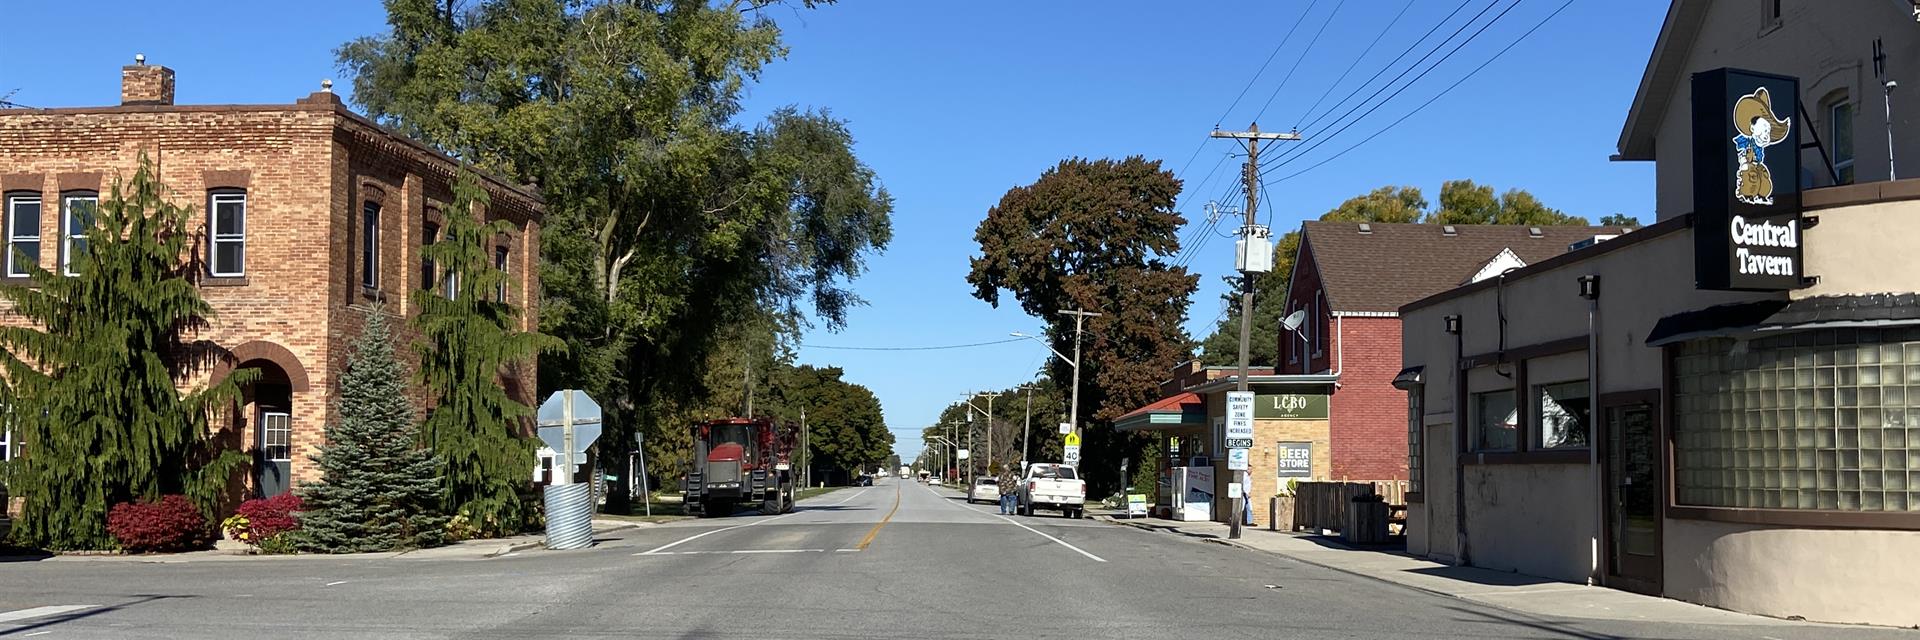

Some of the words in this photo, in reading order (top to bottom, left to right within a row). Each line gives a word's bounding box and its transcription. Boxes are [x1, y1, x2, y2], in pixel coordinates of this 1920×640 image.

[1731, 215, 1797, 248] Central
[1736, 247, 1793, 276] Tavern
[1273, 396, 1307, 409] LCBO
[1228, 439, 1251, 447] BEGINS
[1066, 452, 1077, 460] 40
[1280, 448, 1309, 459] BEER
[1280, 459, 1309, 468] STORE
